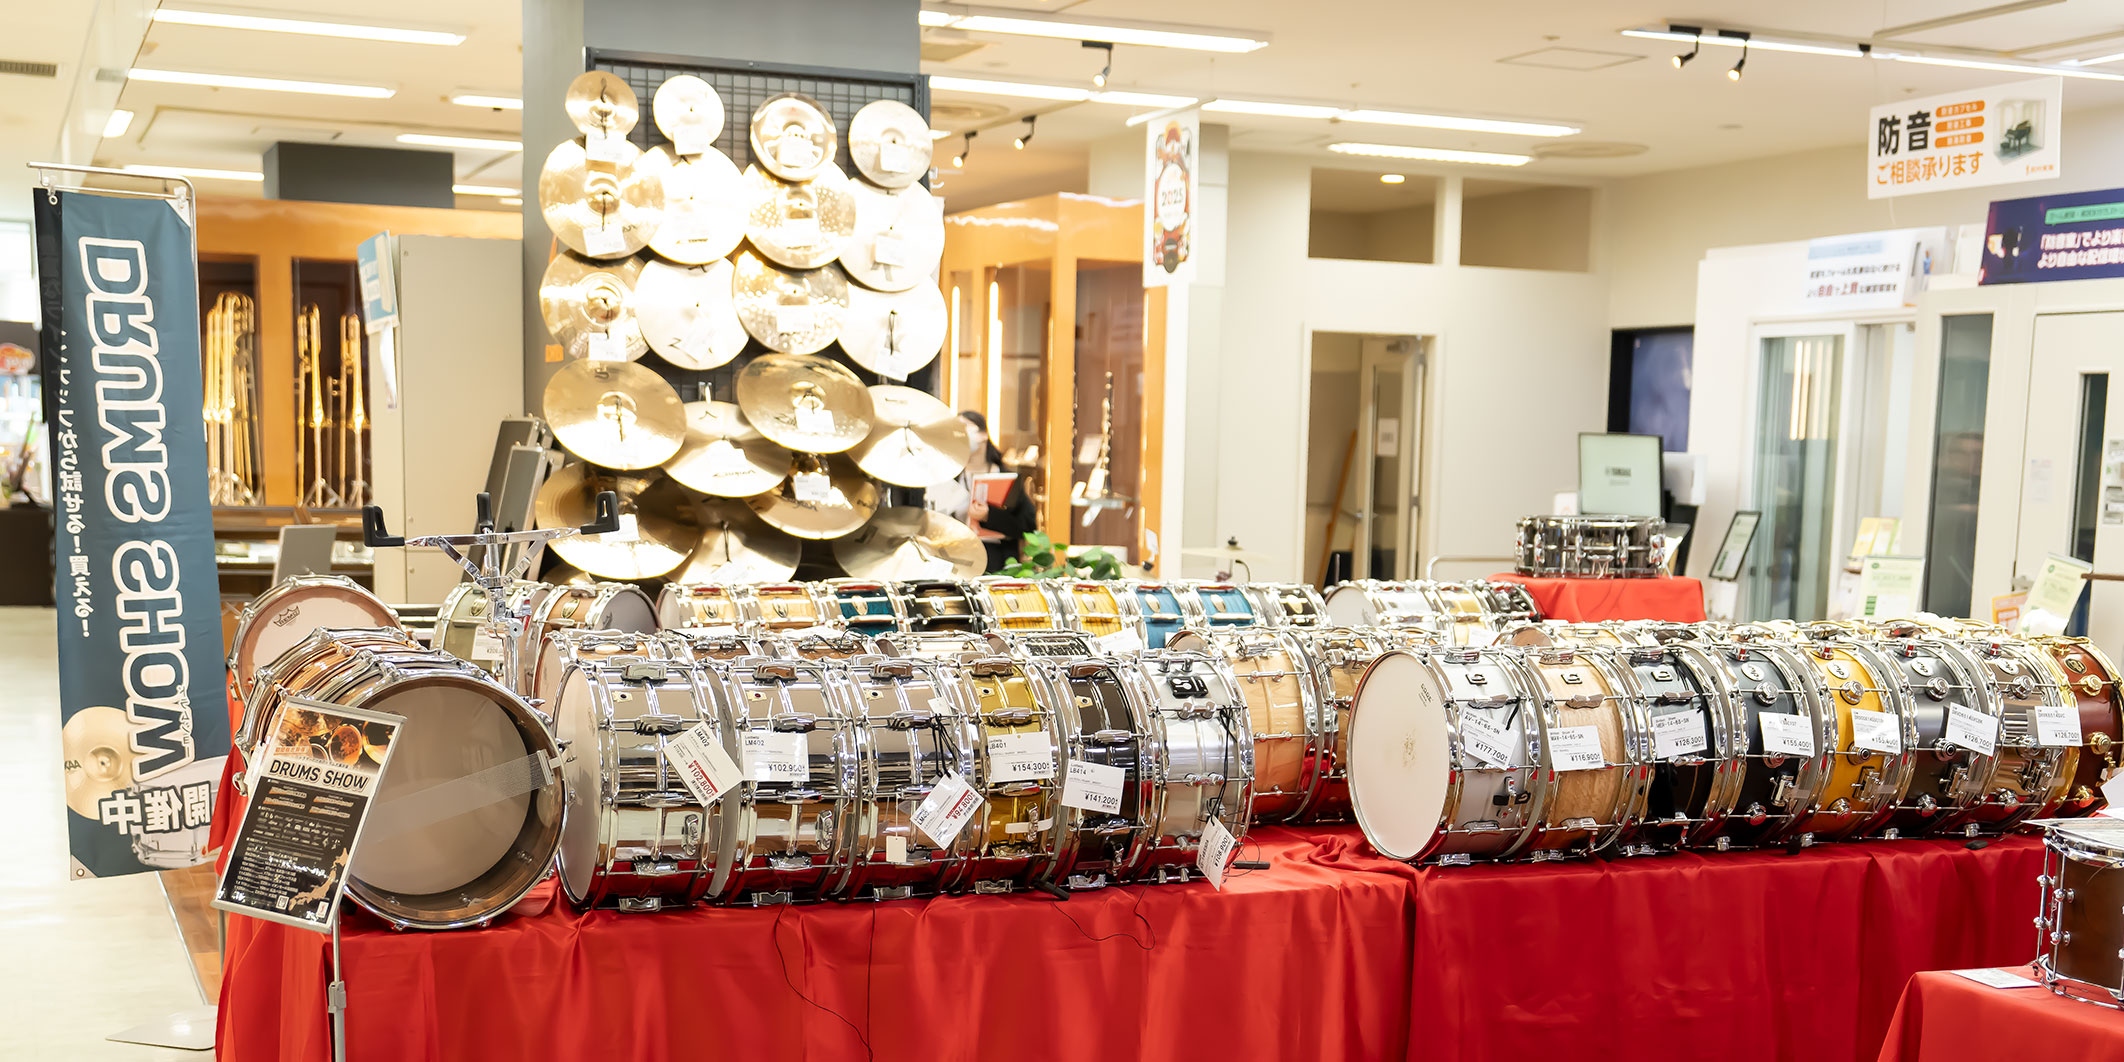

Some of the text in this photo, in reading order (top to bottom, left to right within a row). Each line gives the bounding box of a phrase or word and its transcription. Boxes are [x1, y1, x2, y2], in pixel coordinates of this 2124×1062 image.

[1877, 111, 1932, 157] 防音
[1876, 151, 1984, 185] ご相談承ります
[1161, 188, 1184, 207] 2025
[694, 728, 710, 747] LM402
[269, 759, 321, 782] DRUMS
[323, 770, 369, 789] SHOW
